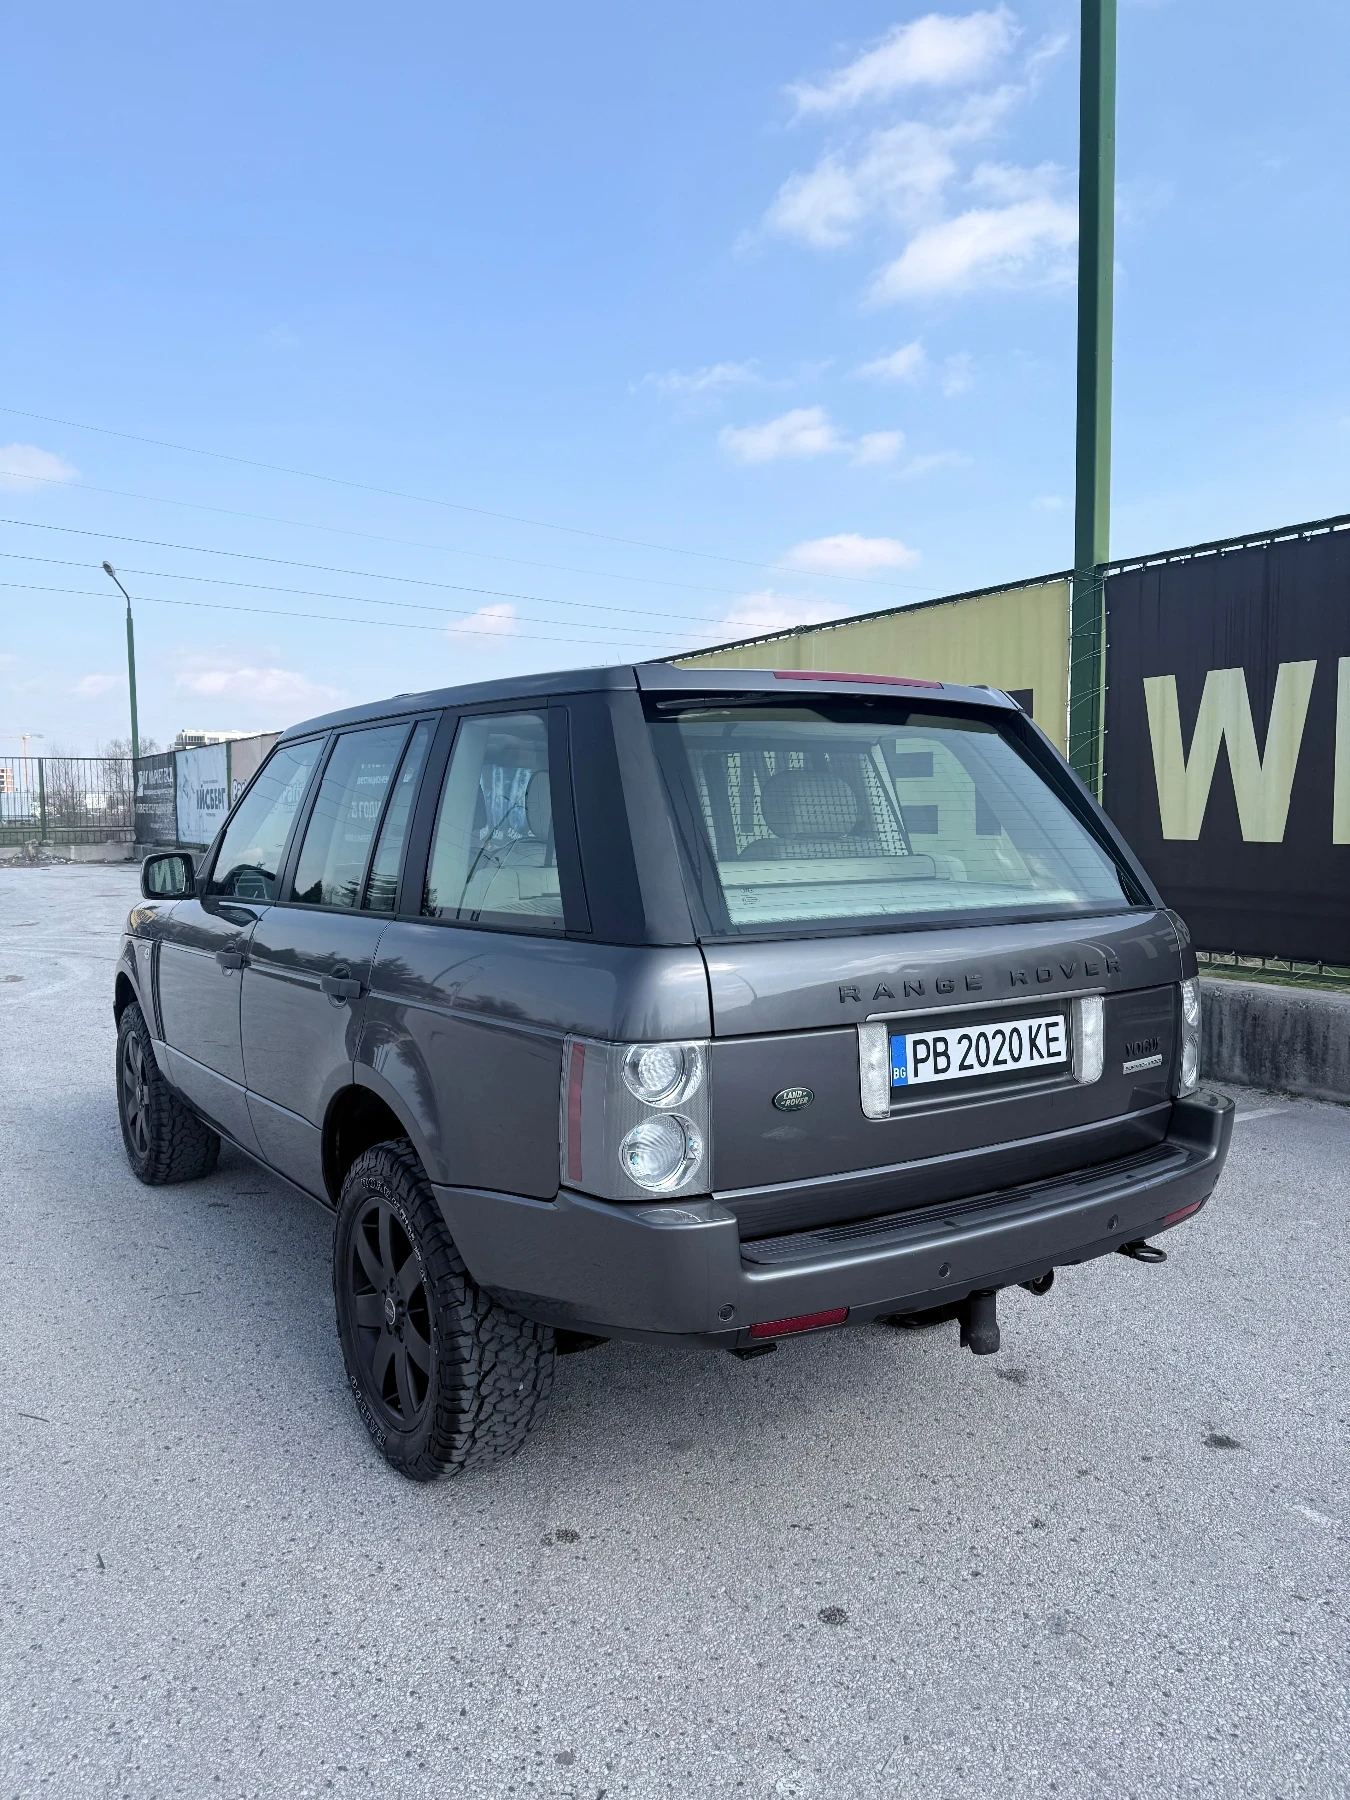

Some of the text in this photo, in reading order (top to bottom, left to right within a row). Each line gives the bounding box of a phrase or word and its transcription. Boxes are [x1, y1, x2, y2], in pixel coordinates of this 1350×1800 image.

[1143, 657, 1350, 845] W
[838, 957, 1122, 1003] RANGE ROVER
[912, 1021, 1062, 1078] PB 2020 KE
[893, 1067, 906, 1079] BG
[783, 1090, 802, 1100] LAND
[785, 1096, 809, 1107] ROVER
